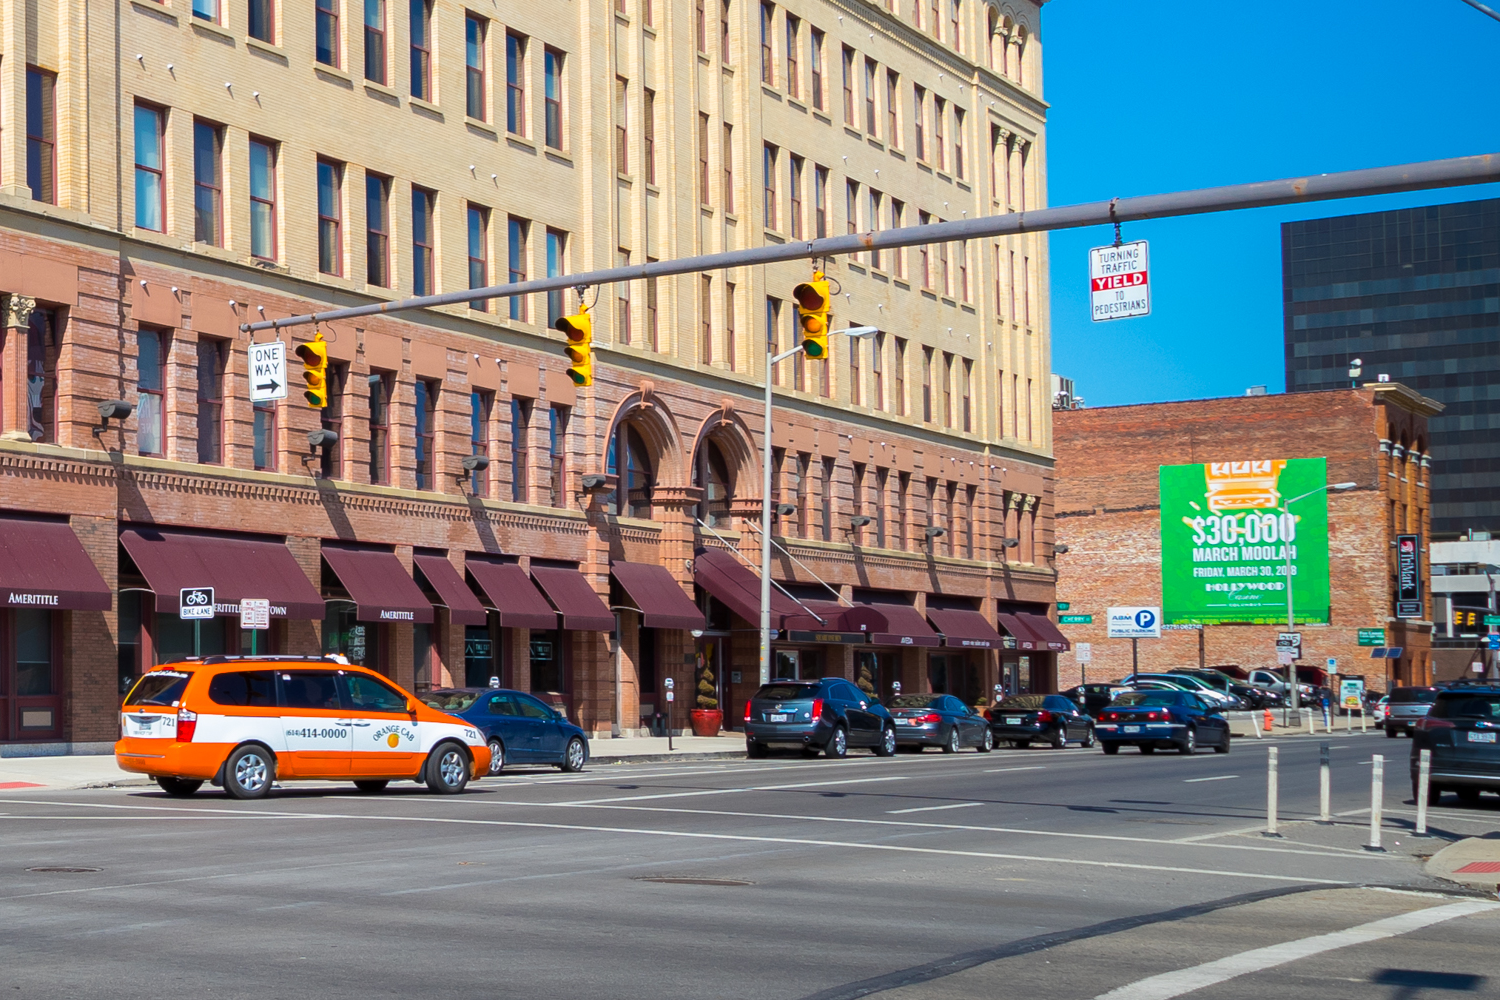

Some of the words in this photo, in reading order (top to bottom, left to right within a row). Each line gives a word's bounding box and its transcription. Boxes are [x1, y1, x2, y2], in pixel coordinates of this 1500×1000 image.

[1099, 249, 1139, 263] TURNING
[1101, 260, 1137, 274] TRAFFIC
[1096, 273, 1143, 290] YIELD
[1116, 291, 1124, 300] TO
[1095, 298, 1146, 315] PEDESTRIANS
[255, 348, 279, 362] ONE
[255, 363, 280, 376] WAY
[1192, 513, 1296, 546] $30,000
[1193, 547, 1238, 562] MARCH
[1242, 545, 1297, 561] MOOLAH
[1227, 566, 1258, 577] MARCH
[1276, 565, 1297, 576] 208
[1401, 555, 1415, 590] TriMark
[1205, 582, 1285, 592] HOLLYWOOD
[8, 592, 59, 605] AMERITITLE
[1228, 591, 1264, 600] Casino
[183, 608, 195, 616] BIKE
[196, 607, 211, 615] LANE
[380, 609, 414, 620] AMERITITLE
[162, 716, 175, 727] 721
[373, 725, 400, 742] ORANGE
[400, 727, 415, 742] CAB
[464, 728, 477, 739] 721
